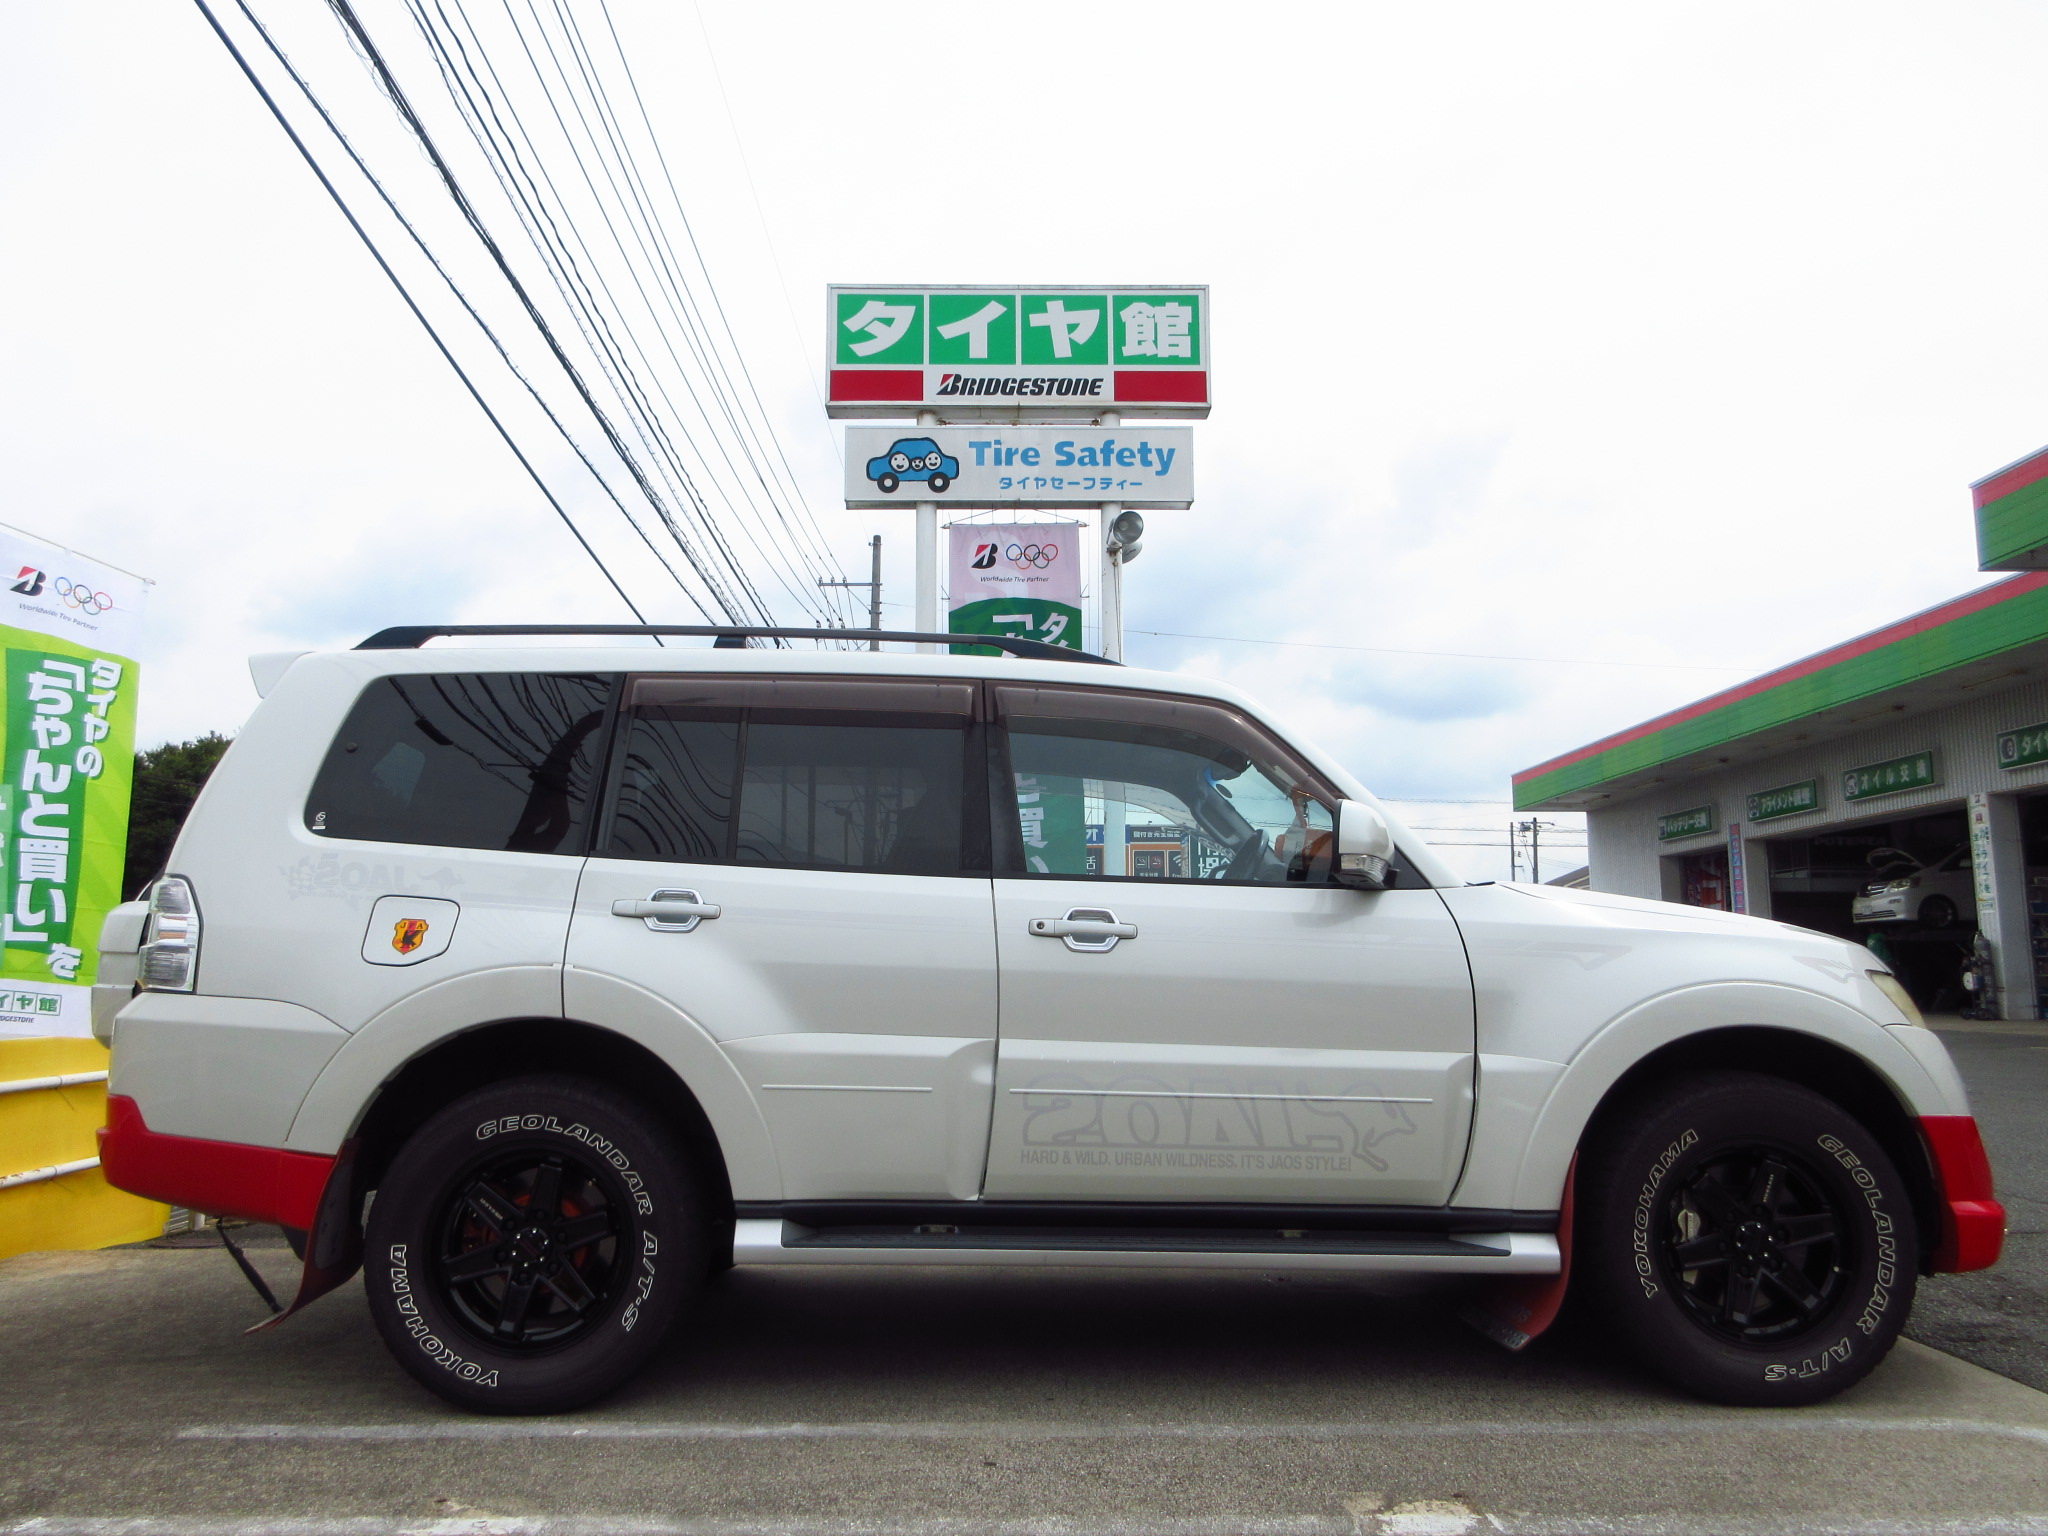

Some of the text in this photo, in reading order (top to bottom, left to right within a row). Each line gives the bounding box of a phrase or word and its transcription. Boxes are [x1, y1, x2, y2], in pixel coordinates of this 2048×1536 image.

[843, 300, 1192, 359] タイヤ館
[936, 373, 1104, 396] BRIDGESTONE
[969, 439, 1176, 476] Tire Safety
[999, 476, 1142, 491] タイヤセーフティー
[59, 612, 72, 622] Tire
[72, 618, 98, 631] Partner
[76, 658, 123, 778] タイヤの
[47, 943, 82, 979] を
[476, 1114, 653, 1216] GEOLANDAR
[1020, 1150, 1352, 1172] HARD & WILD. URBAN WILDNESS. IT'S JAOS STYLE!
[1633, 1129, 1699, 1299] YOKOHAMA
[1817, 1134, 1896, 1335] GEOLANDAR
[391, 1244, 499, 1387] YOKOHAMA
